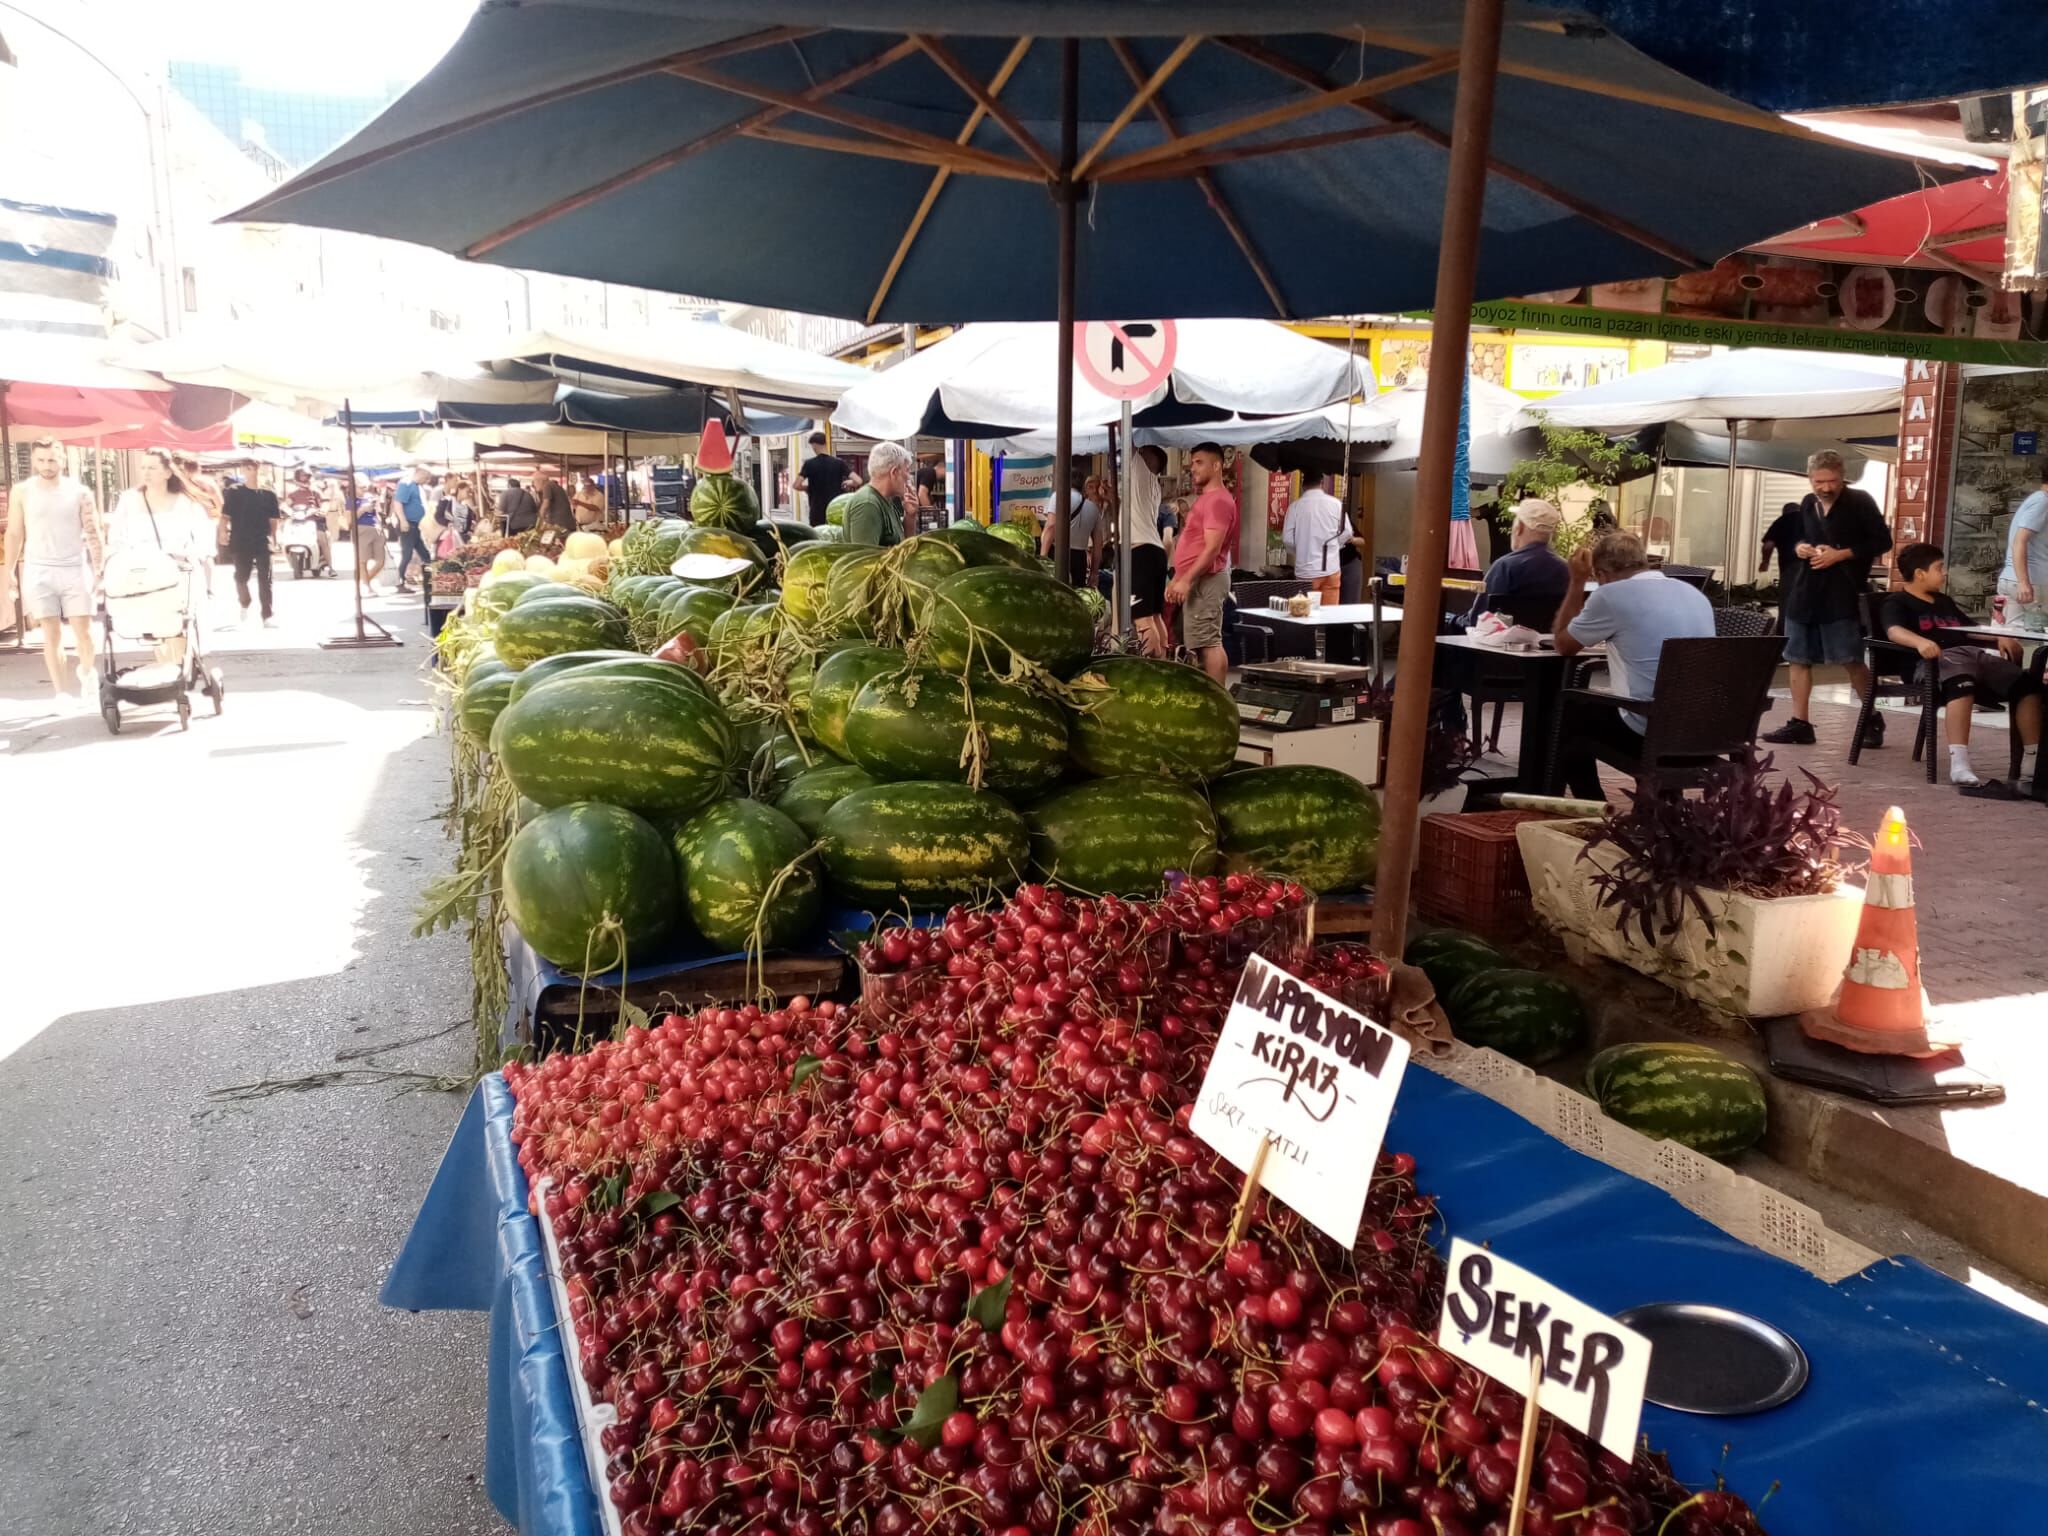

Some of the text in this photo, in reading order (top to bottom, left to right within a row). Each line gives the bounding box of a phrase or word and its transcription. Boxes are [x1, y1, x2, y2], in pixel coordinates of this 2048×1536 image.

[1561, 314, 1601, 329] cuma
[1658, 321, 1699, 338] içinde
[1704, 326, 1733, 340] eski
[1736, 329, 1788, 345] yerinde
[1792, 332, 1829, 348] tekrar
[1235, 958, 1393, 1079] NAPOLYON
[1446, 1253, 1625, 1441] ŞEKER
